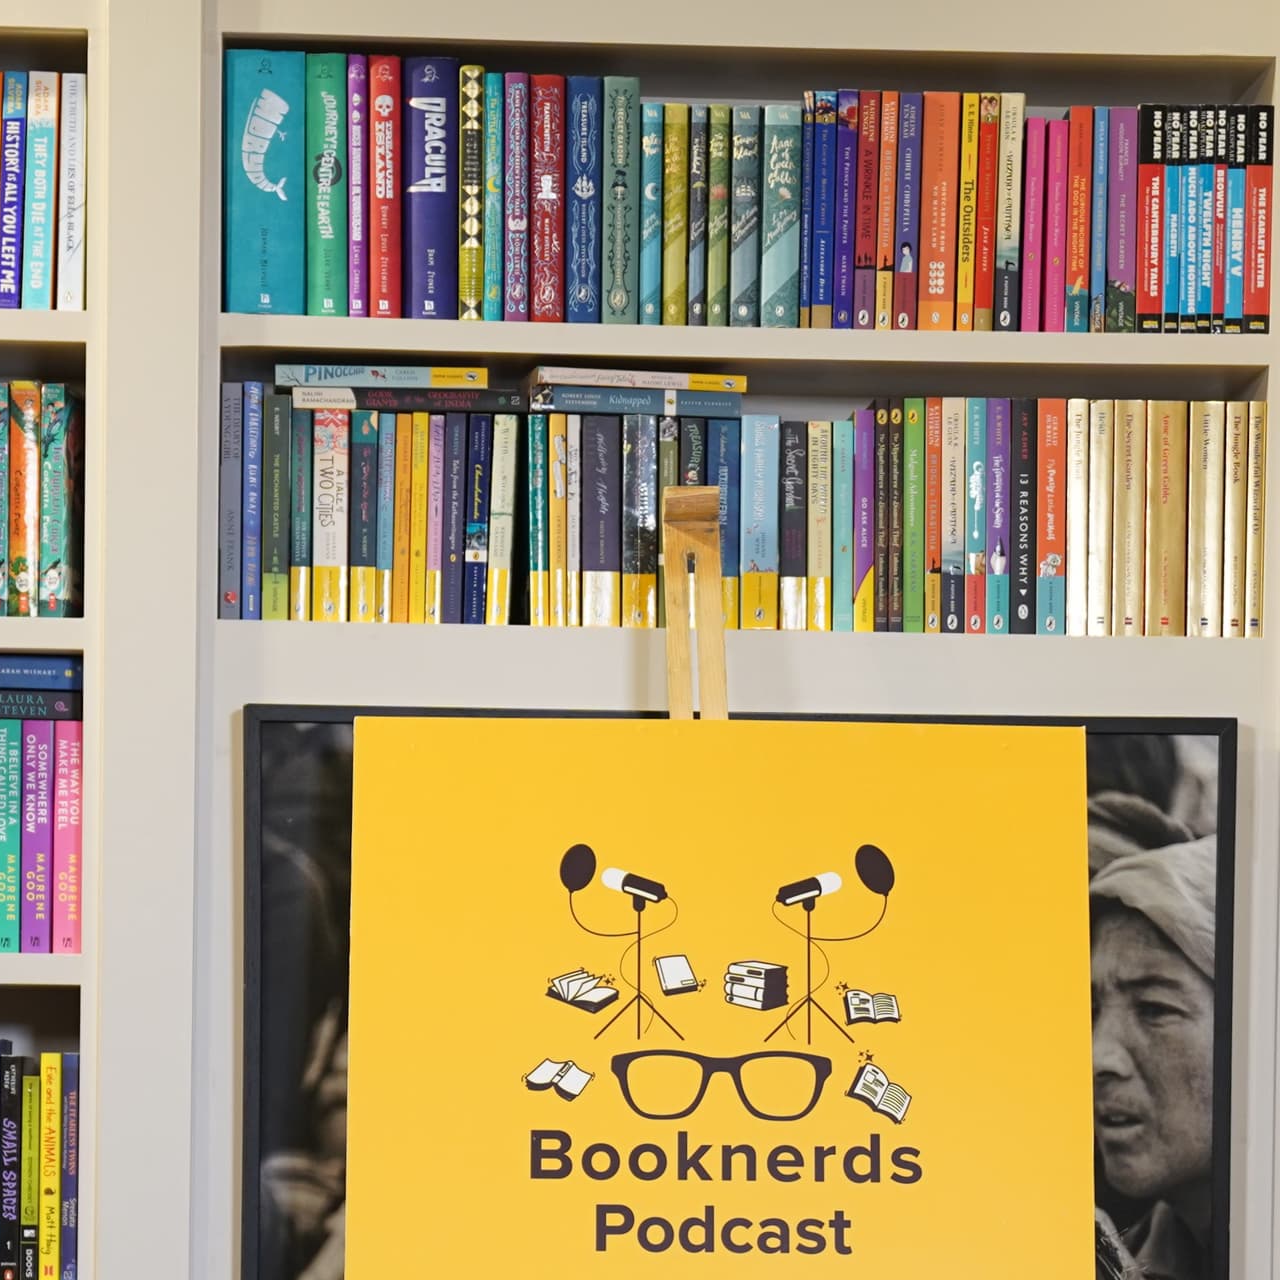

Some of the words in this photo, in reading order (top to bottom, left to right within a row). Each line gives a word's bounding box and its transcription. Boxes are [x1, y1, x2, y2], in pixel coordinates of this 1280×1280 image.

[543, 102, 551, 152] FRANKENSTEIN
[1237, 114, 1245, 131] NO
[35, 137, 48, 165] THEY
[406, 97, 446, 193] DRACULA
[1236, 134, 1245, 162] FEAR
[33, 169, 48, 199] BOTH
[963, 180, 974, 202] The
[1258, 188, 1266, 207] THE
[32, 202, 48, 223] DIE
[34, 225, 44, 238] AT
[961, 205, 973, 263] Outsiders
[1231, 208, 1243, 260] HENRY
[1257, 209, 1266, 251] SCARLET
[32, 240, 44, 258] THE
[31, 261, 44, 289] END
[1231, 262, 1242, 277] V
[1256, 253, 1265, 288] LETTER
[319, 456, 334, 490] TWO
[1019, 473, 1028, 485] 13
[861, 497, 867, 507] GO
[1019, 491, 1028, 550] REASONS
[1019, 555, 1028, 583] WHY
[26, 734, 36, 768] ONLY
[26, 772, 36, 790] WE
[37, 743, 47, 824] SOMEWHERE
[26, 794, 36, 833] KNOW
[2, 1118, 16, 1166] SMALL
[530, 1130, 923, 1184] Booknerds
[2, 1171, 16, 1221] SPACES
[595, 1204, 853, 1255] Podcast
